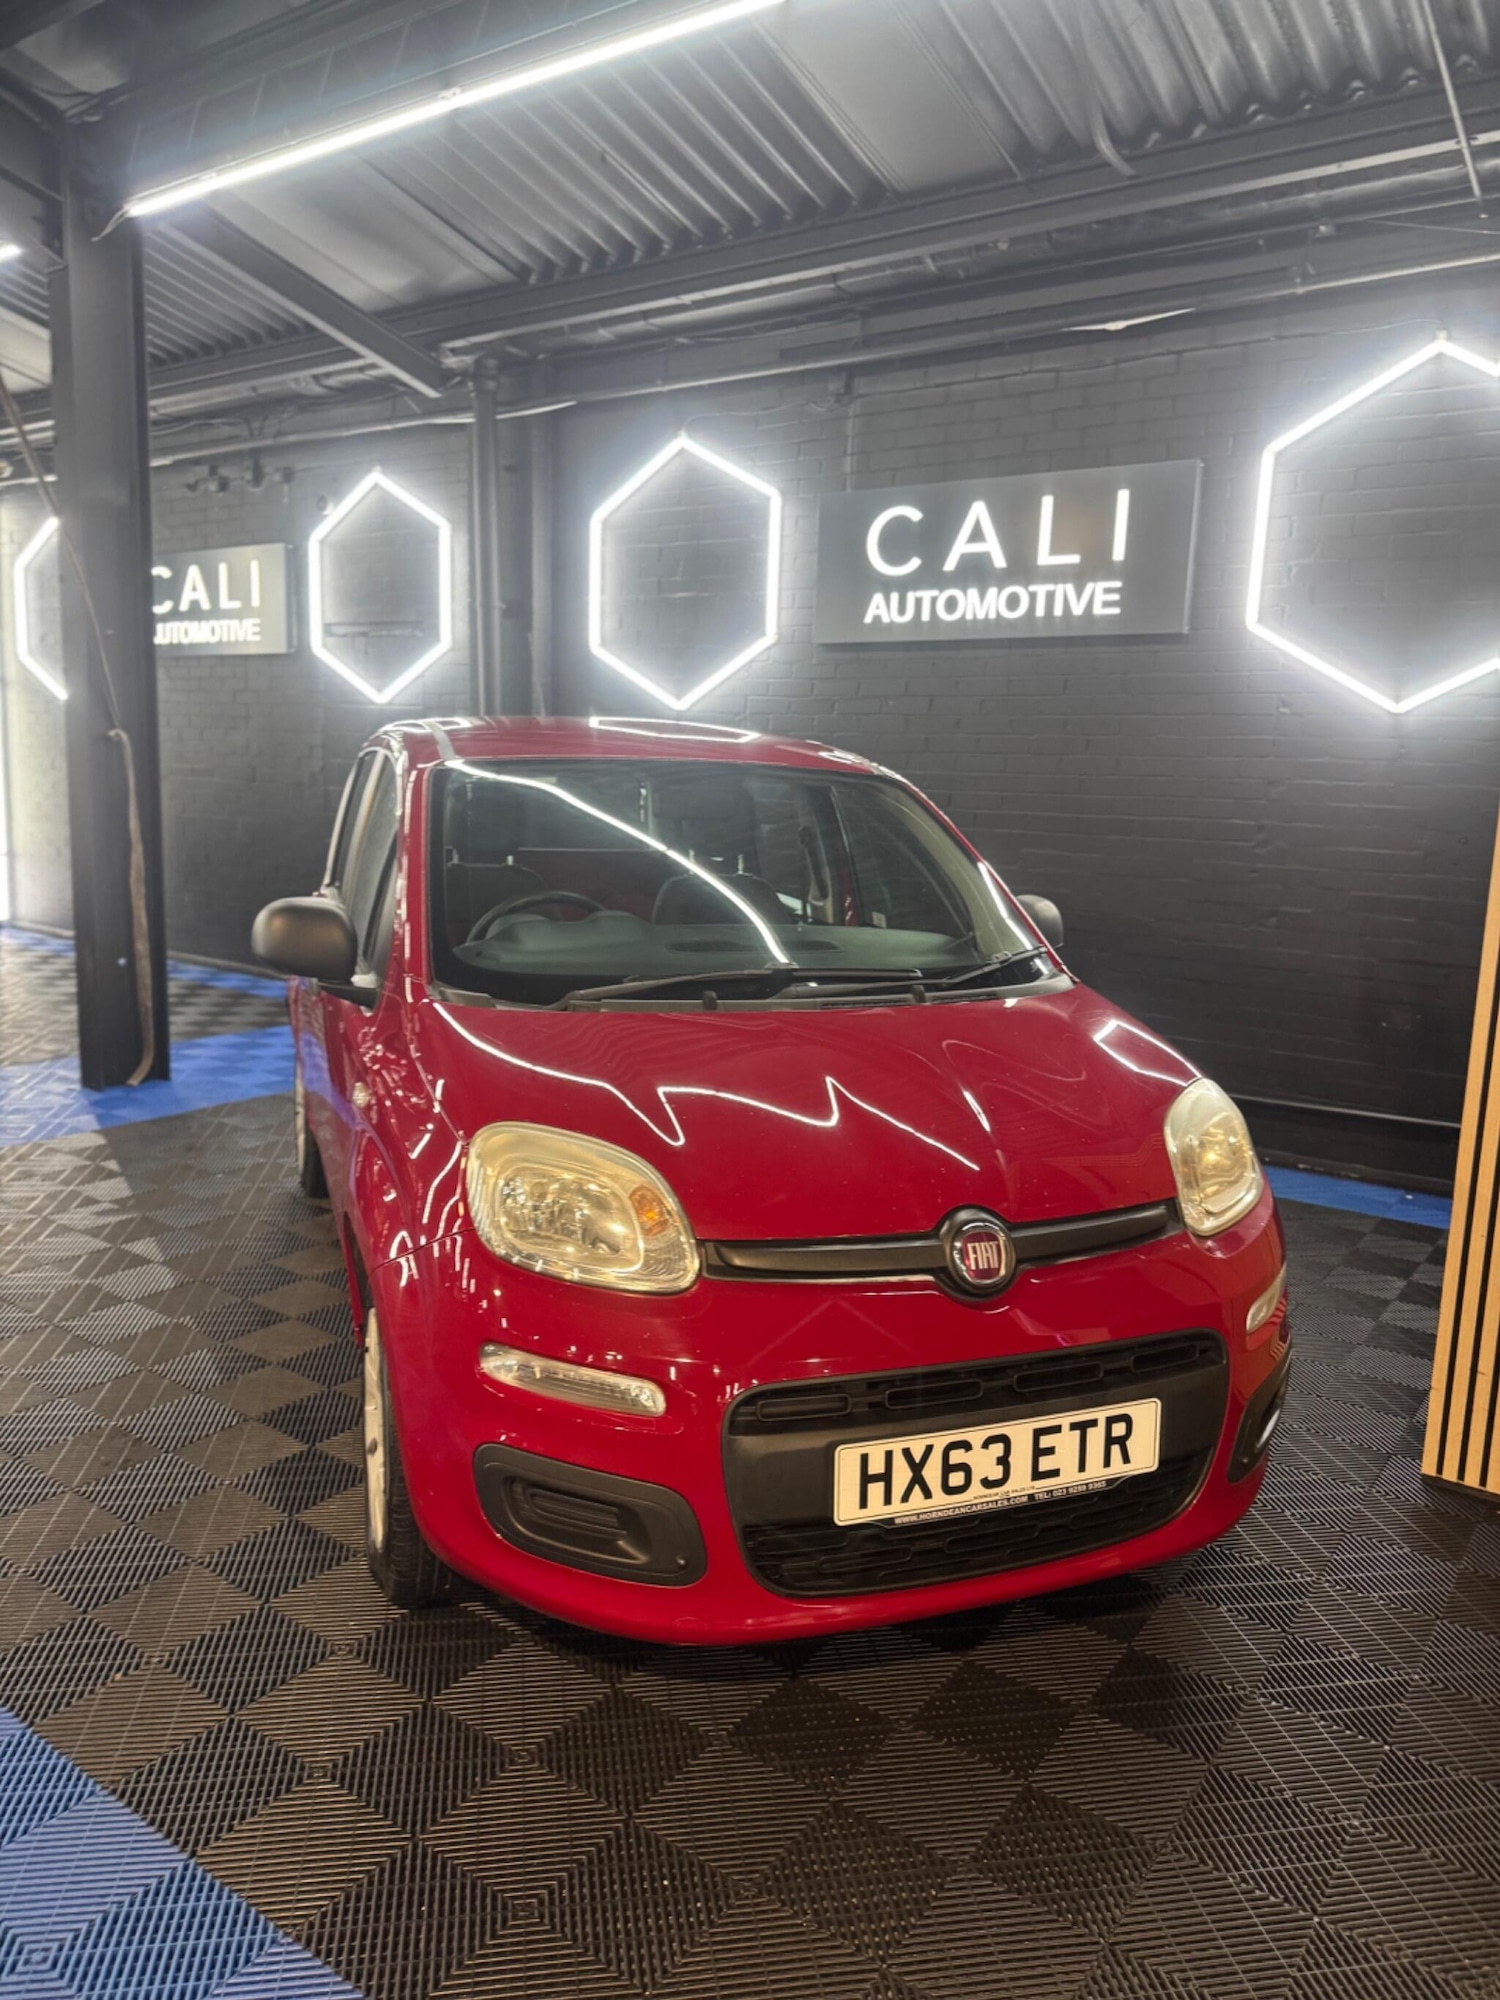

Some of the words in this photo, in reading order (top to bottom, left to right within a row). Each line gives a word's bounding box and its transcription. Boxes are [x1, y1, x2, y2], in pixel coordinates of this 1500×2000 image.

[865, 488, 1130, 576] CALI
[863, 580, 1123, 624] AUTOMOTIVE
[153, 617, 262, 645] UTOMOTIVE
[966, 1240, 999, 1270] FIAT
[858, 1432, 1012, 1510] HX63
[1030, 1412, 1133, 1483] ETR
